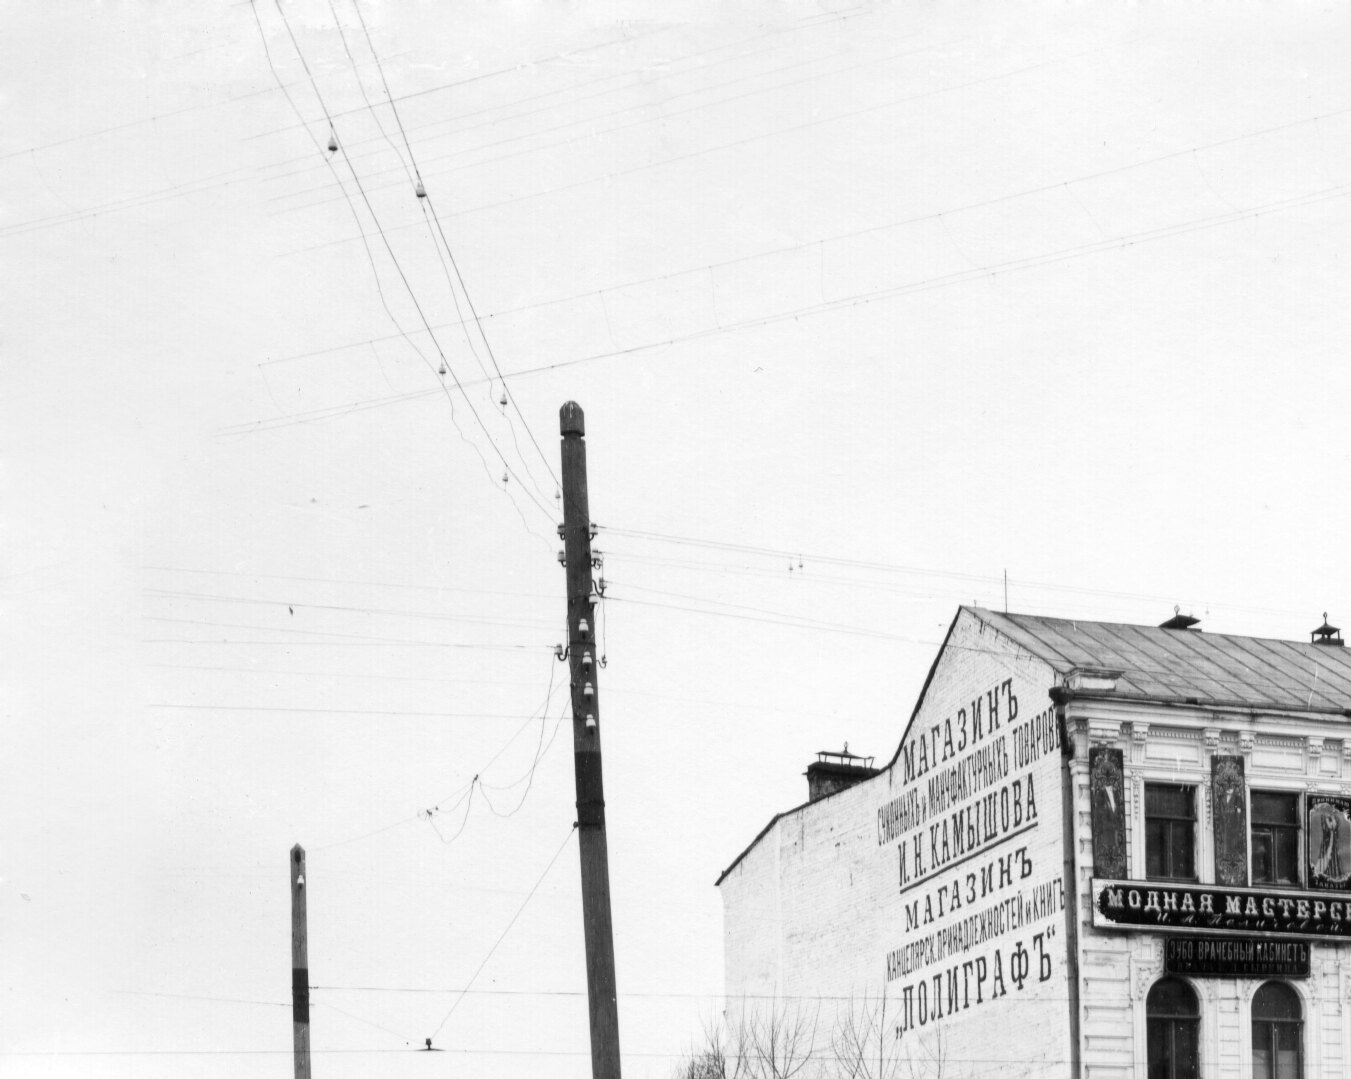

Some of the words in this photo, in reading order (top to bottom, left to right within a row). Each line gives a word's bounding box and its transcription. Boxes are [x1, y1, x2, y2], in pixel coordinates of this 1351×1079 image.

[902, 678, 1018, 785] МАГАЗИНЪ
[878, 787, 920, 846] СУКОННЫХЪ
[928, 735, 1008, 817] МАНУФАКТУРНЫХЪ
[1012, 707, 1061, 771] ТОВАРОВЪ
[898, 842, 911, 887] И.
[914, 827, 927, 880] Н.
[930, 772, 1038, 870] КАМЫШОВА
[905, 846, 1032, 933] МАГАЗИНЪ
[937, 891, 1024, 961] ПРИНАДЛЕЖНОСТЕЙ
[1033, 876, 1066, 920] КНИГЪ
[1107, 888, 1214, 914] МОДНАЯ
[1170, 940, 1193, 960] ЗУБО
[1198, 939, 1254, 961] ВРАЧЕБНЫЙ
[1257, 941, 1306, 962] КАБИНЕТЪ
